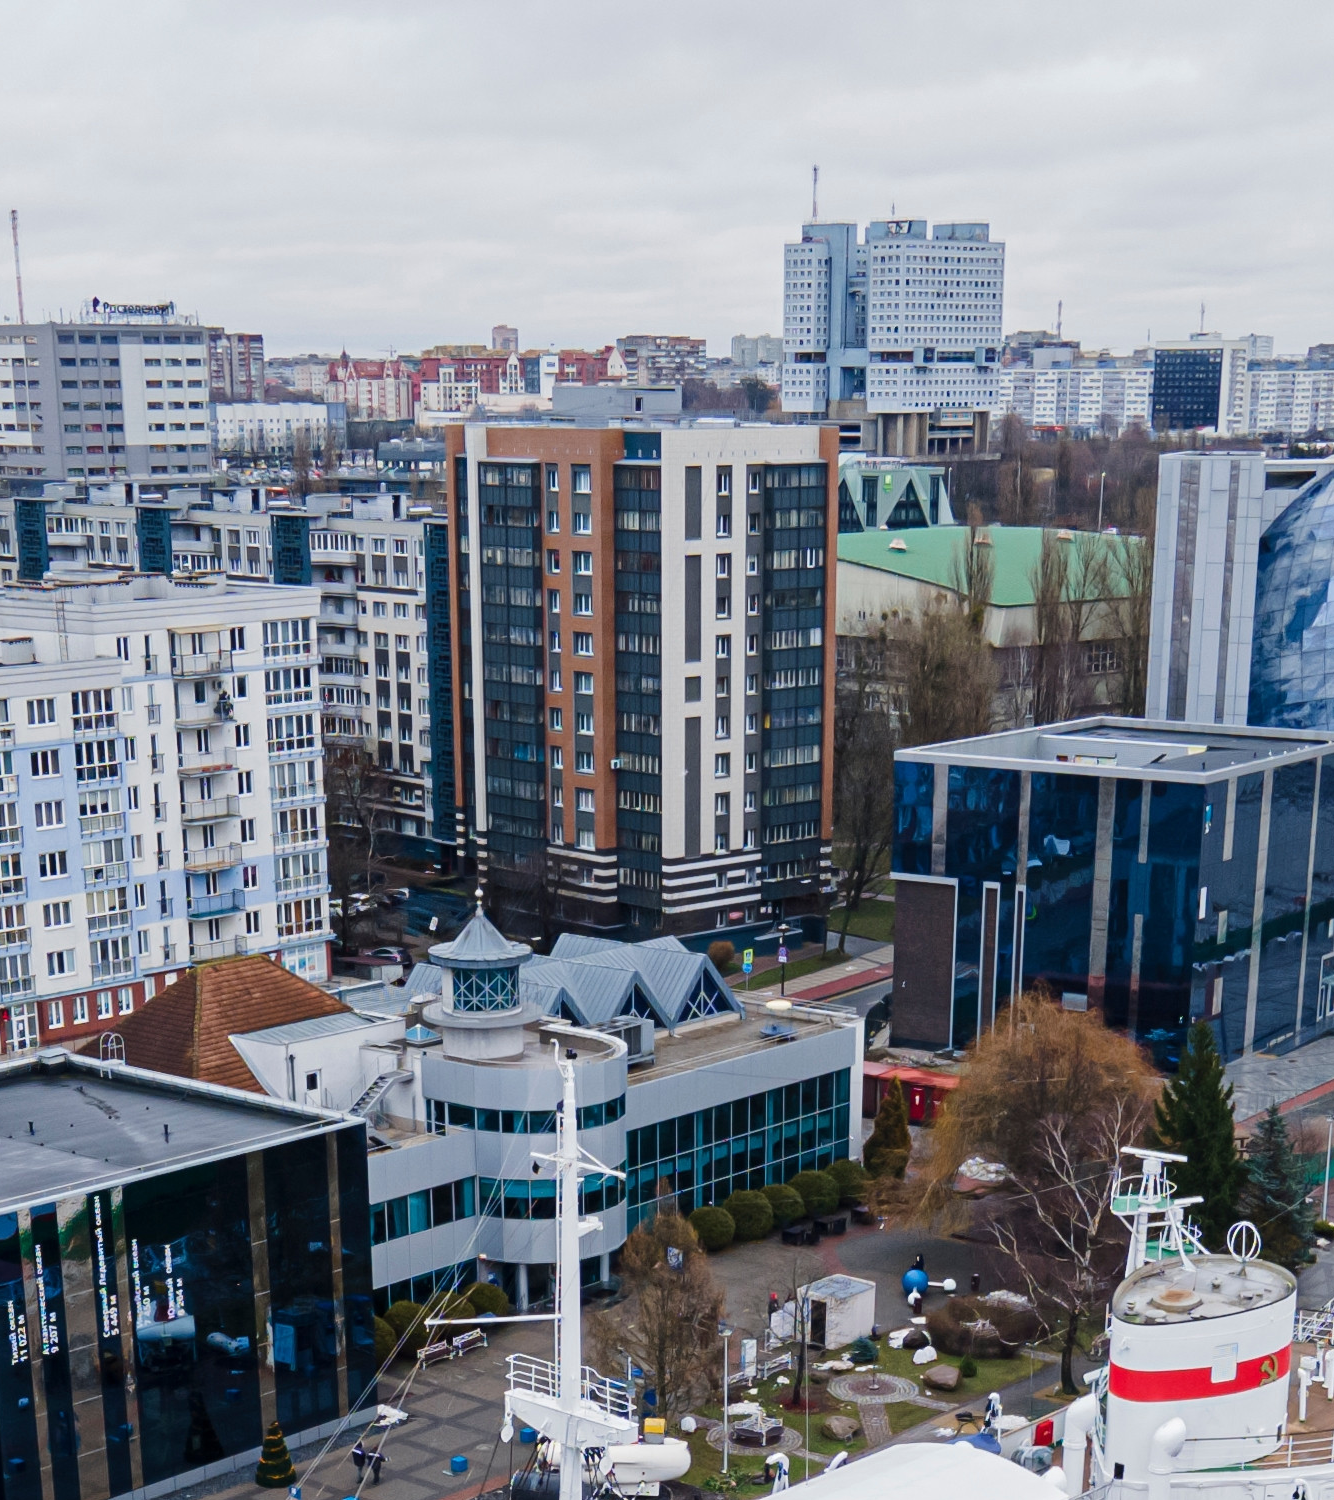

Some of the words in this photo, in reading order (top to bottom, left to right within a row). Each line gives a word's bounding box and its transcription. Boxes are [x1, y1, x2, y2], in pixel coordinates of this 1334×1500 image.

[94, 1195, 102, 1226] океан
[131, 1239, 139, 1268] океан
[7, 1300, 16, 1330] океан
[9, 1332, 18, 1365] Тихий
